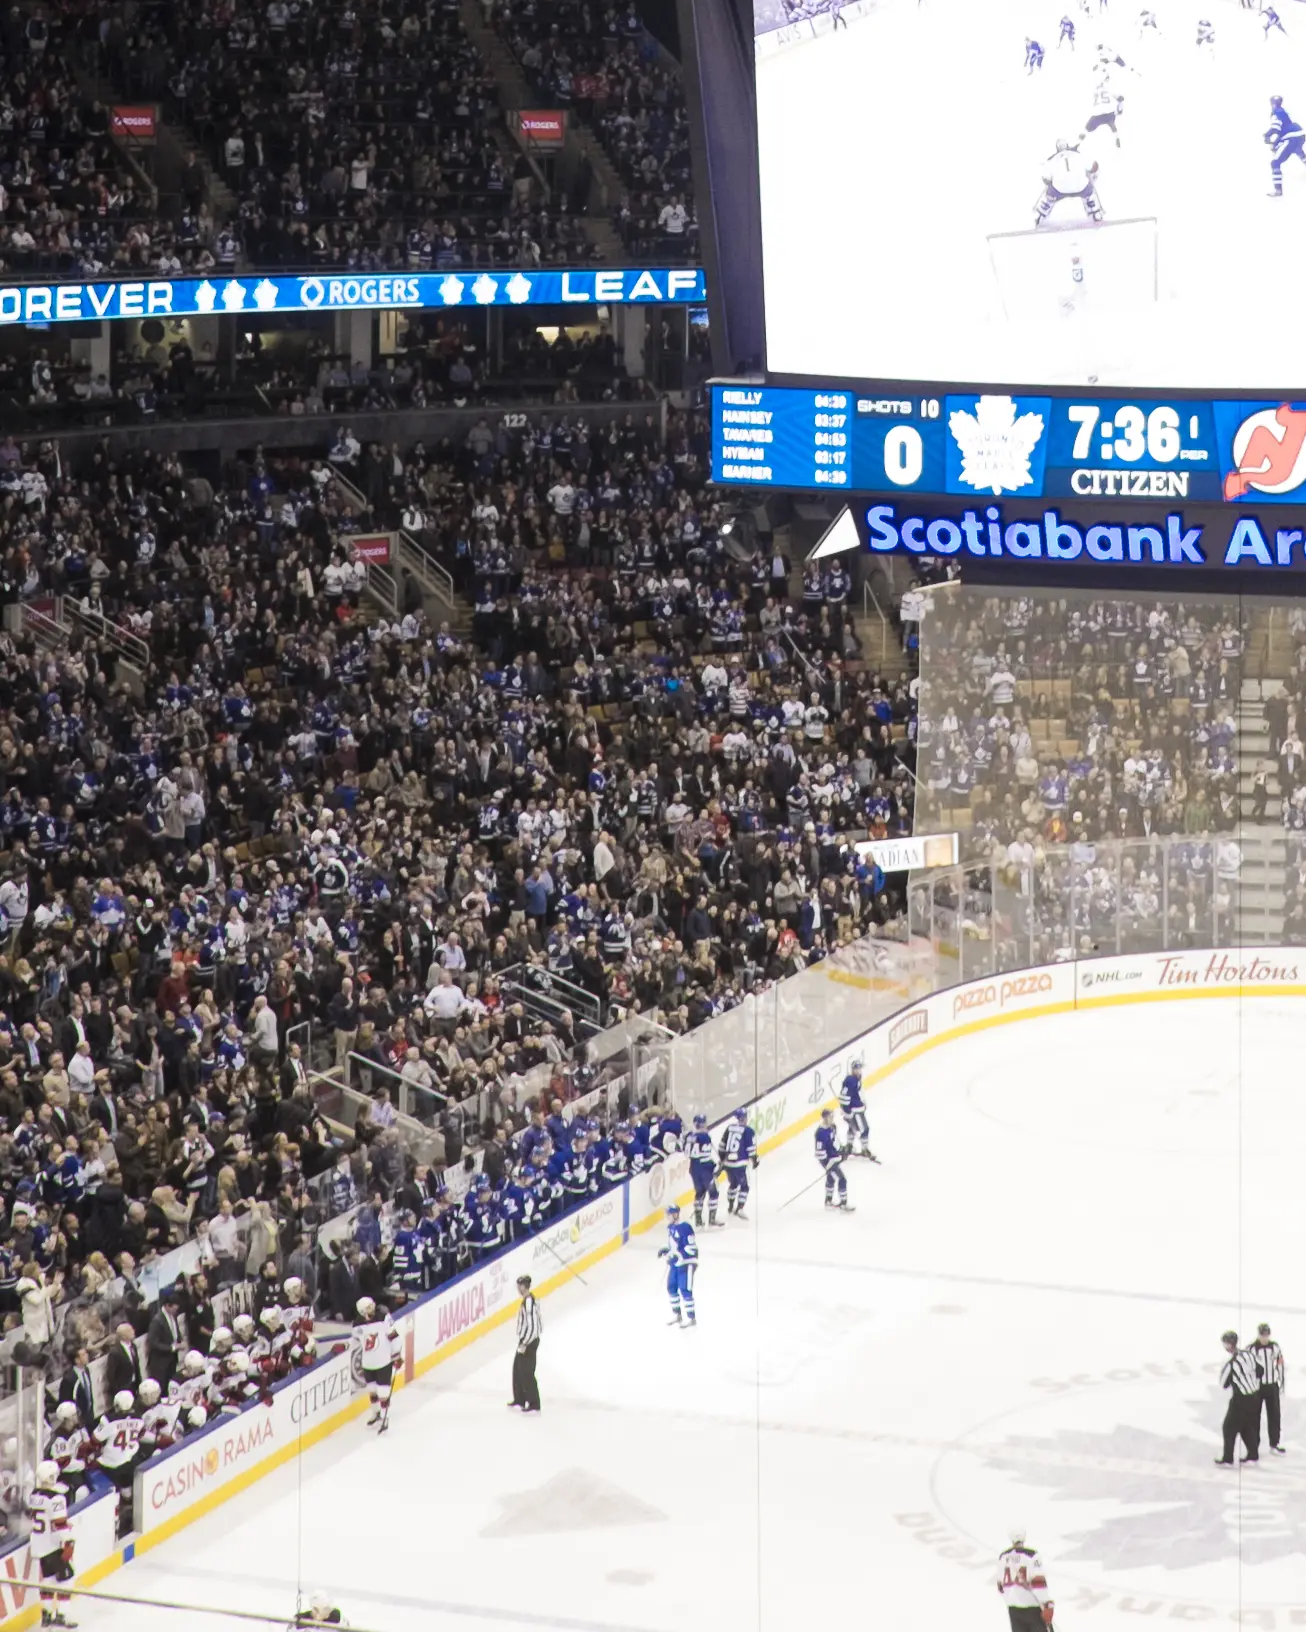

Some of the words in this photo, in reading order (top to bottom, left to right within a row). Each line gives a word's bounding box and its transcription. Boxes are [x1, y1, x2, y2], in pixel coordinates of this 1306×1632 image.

[328, 277, 420, 305] ROGERS
[561, 270, 706, 302] LEAF
[503, 413, 528, 428] 122
[857, 399, 912, 415] SHOTS
[920, 399, 940, 419] 10
[1068, 405, 1181, 463] 7:36
[883, 425, 924, 486] 0
[1070, 468, 1190, 497] CITIZEN
[866, 504, 1206, 566] Scotiabank
[1095, 970, 1143, 984] NHL.COM
[1156, 954, 1199, 986] Tim
[1203, 953, 1300, 983] Hortons
[953, 985, 997, 1020] pizza
[1000, 971, 1053, 1007] pizza
[725, 1131, 742, 1154] 16
[435, 1282, 486, 1346] JAMAICA
[151, 1446, 220, 1511] CASINO
[222, 1418, 275, 1467] RAMA
